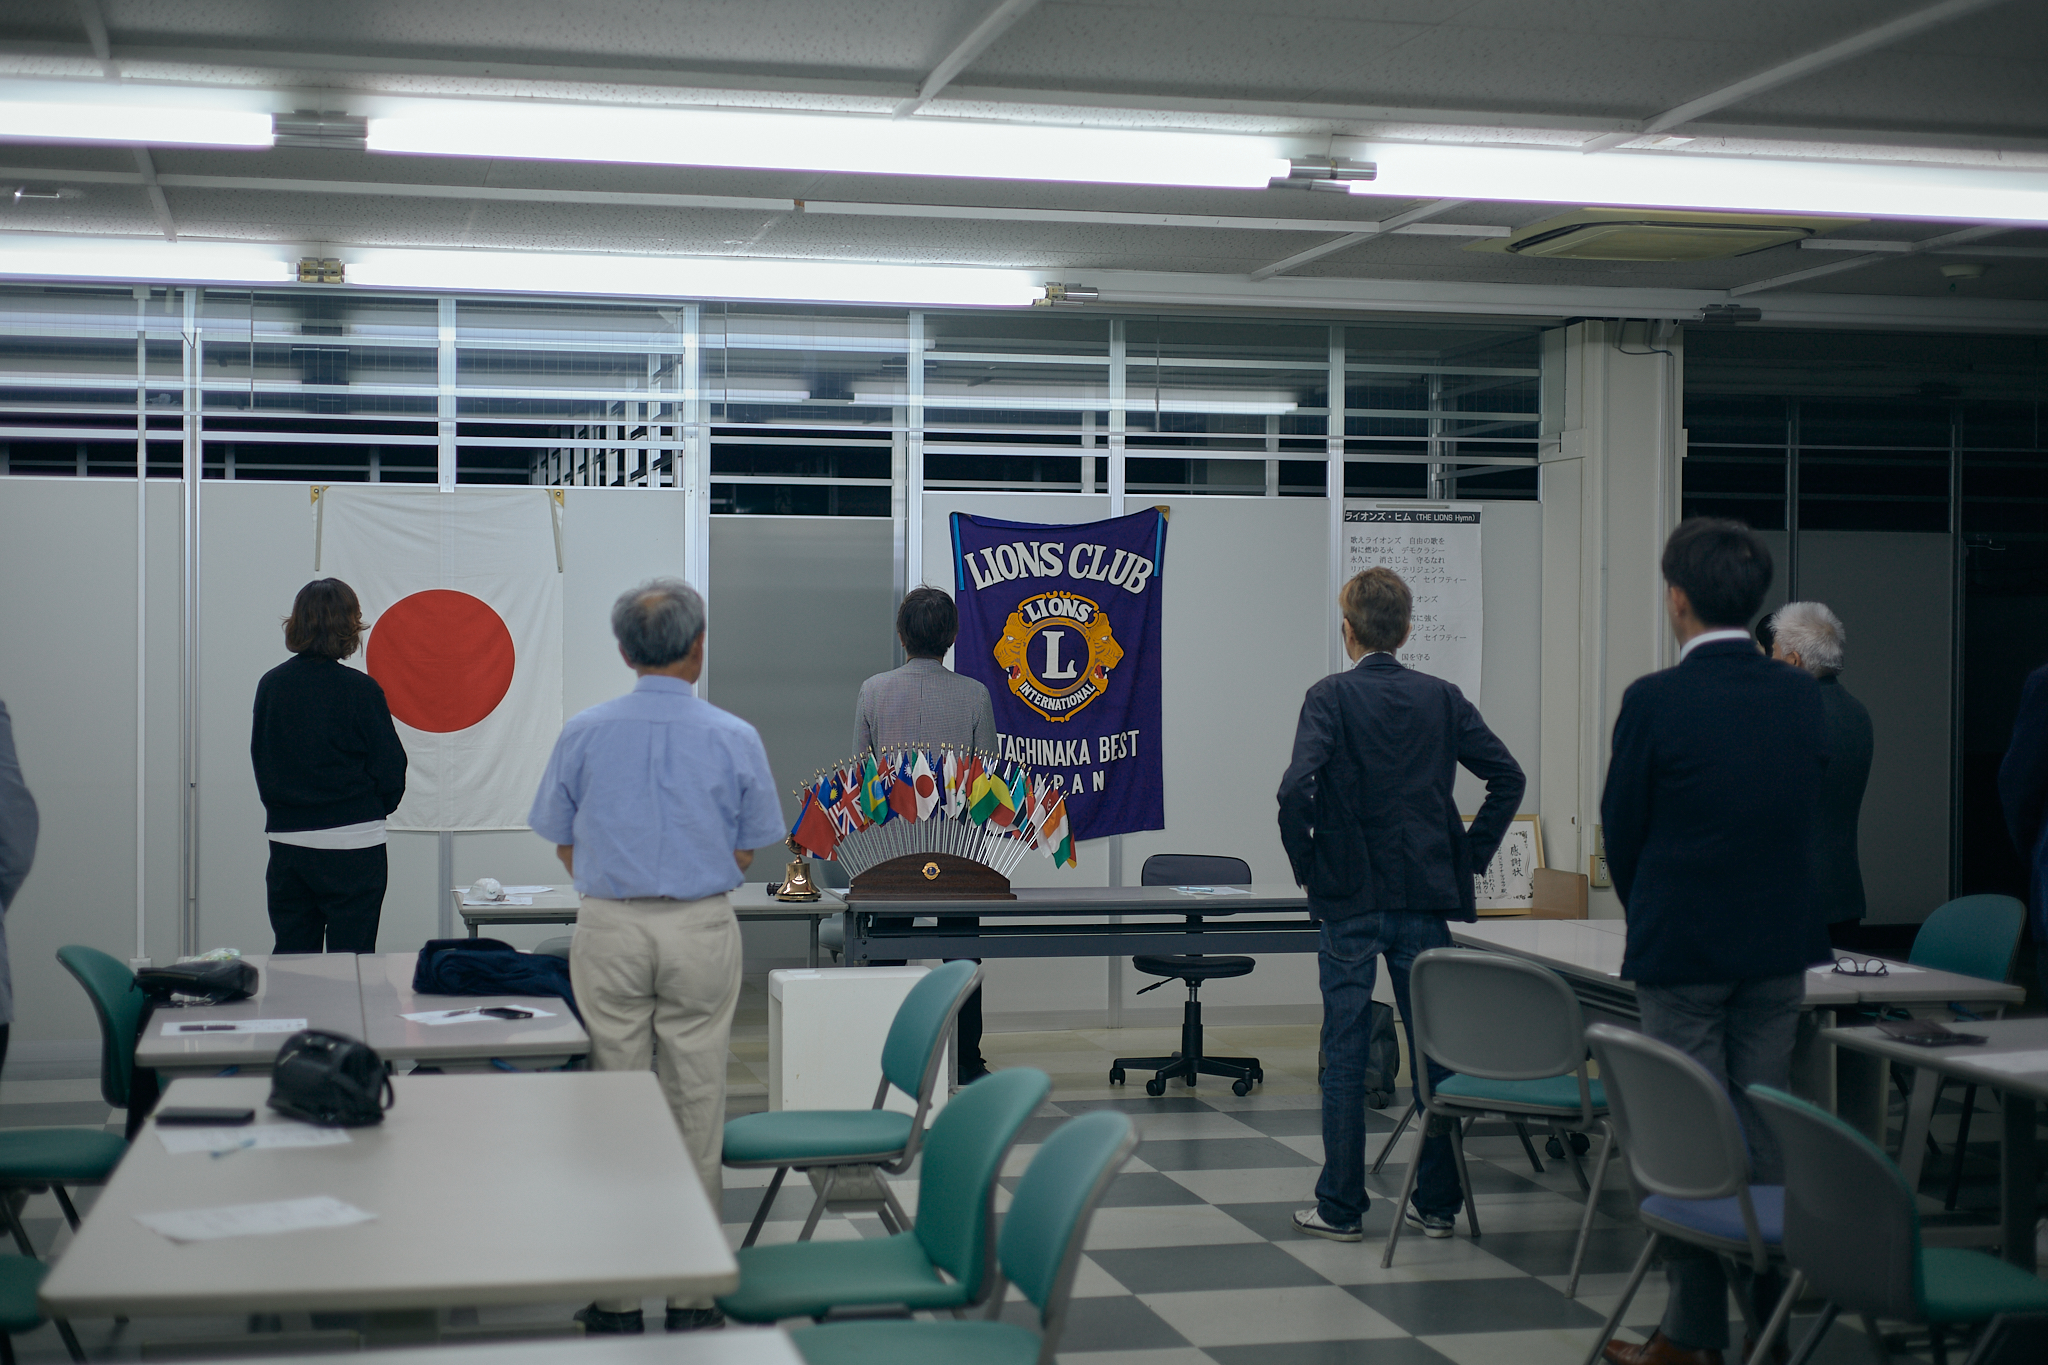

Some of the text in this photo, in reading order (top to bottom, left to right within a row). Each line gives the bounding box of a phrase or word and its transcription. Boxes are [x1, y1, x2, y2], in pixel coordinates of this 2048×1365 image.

[1345, 512, 1412, 522] ライオンズ・ヒム
[1434, 513, 1453, 522] LIONS
[964, 541, 1154, 594] LIONS CLUB
[1023, 598, 1093, 623] LIONS
[1042, 630, 1077, 679] L
[1018, 681, 1097, 711] INTERNATIONAL
[996, 729, 1140, 767] TACHINAKA BEST
[1034, 770, 1105, 795] APAN
[1510, 843, 1524, 877] 感謝状
